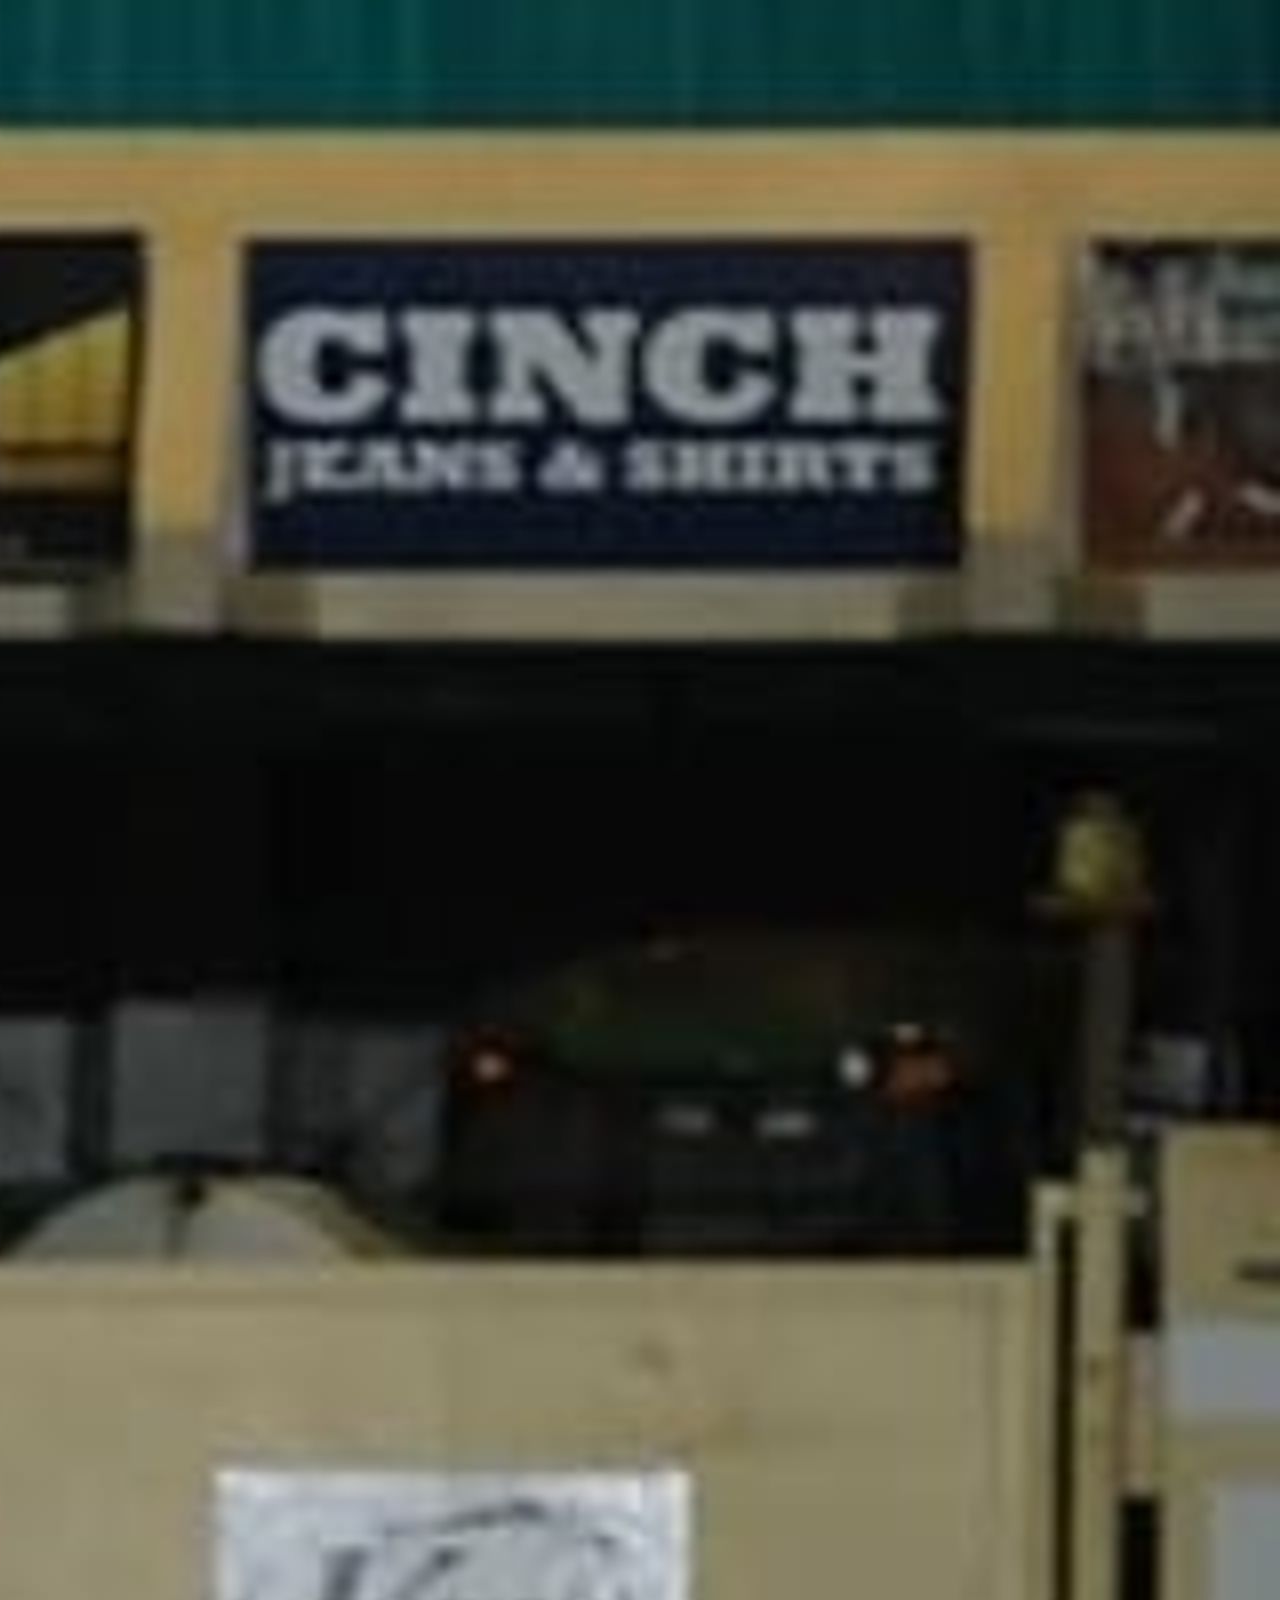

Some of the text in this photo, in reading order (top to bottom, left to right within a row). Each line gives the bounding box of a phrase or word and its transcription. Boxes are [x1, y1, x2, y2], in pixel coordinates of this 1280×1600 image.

[257, 306, 946, 425] CINCH
[265, 438, 940, 503] JEANS & SHIRTS
